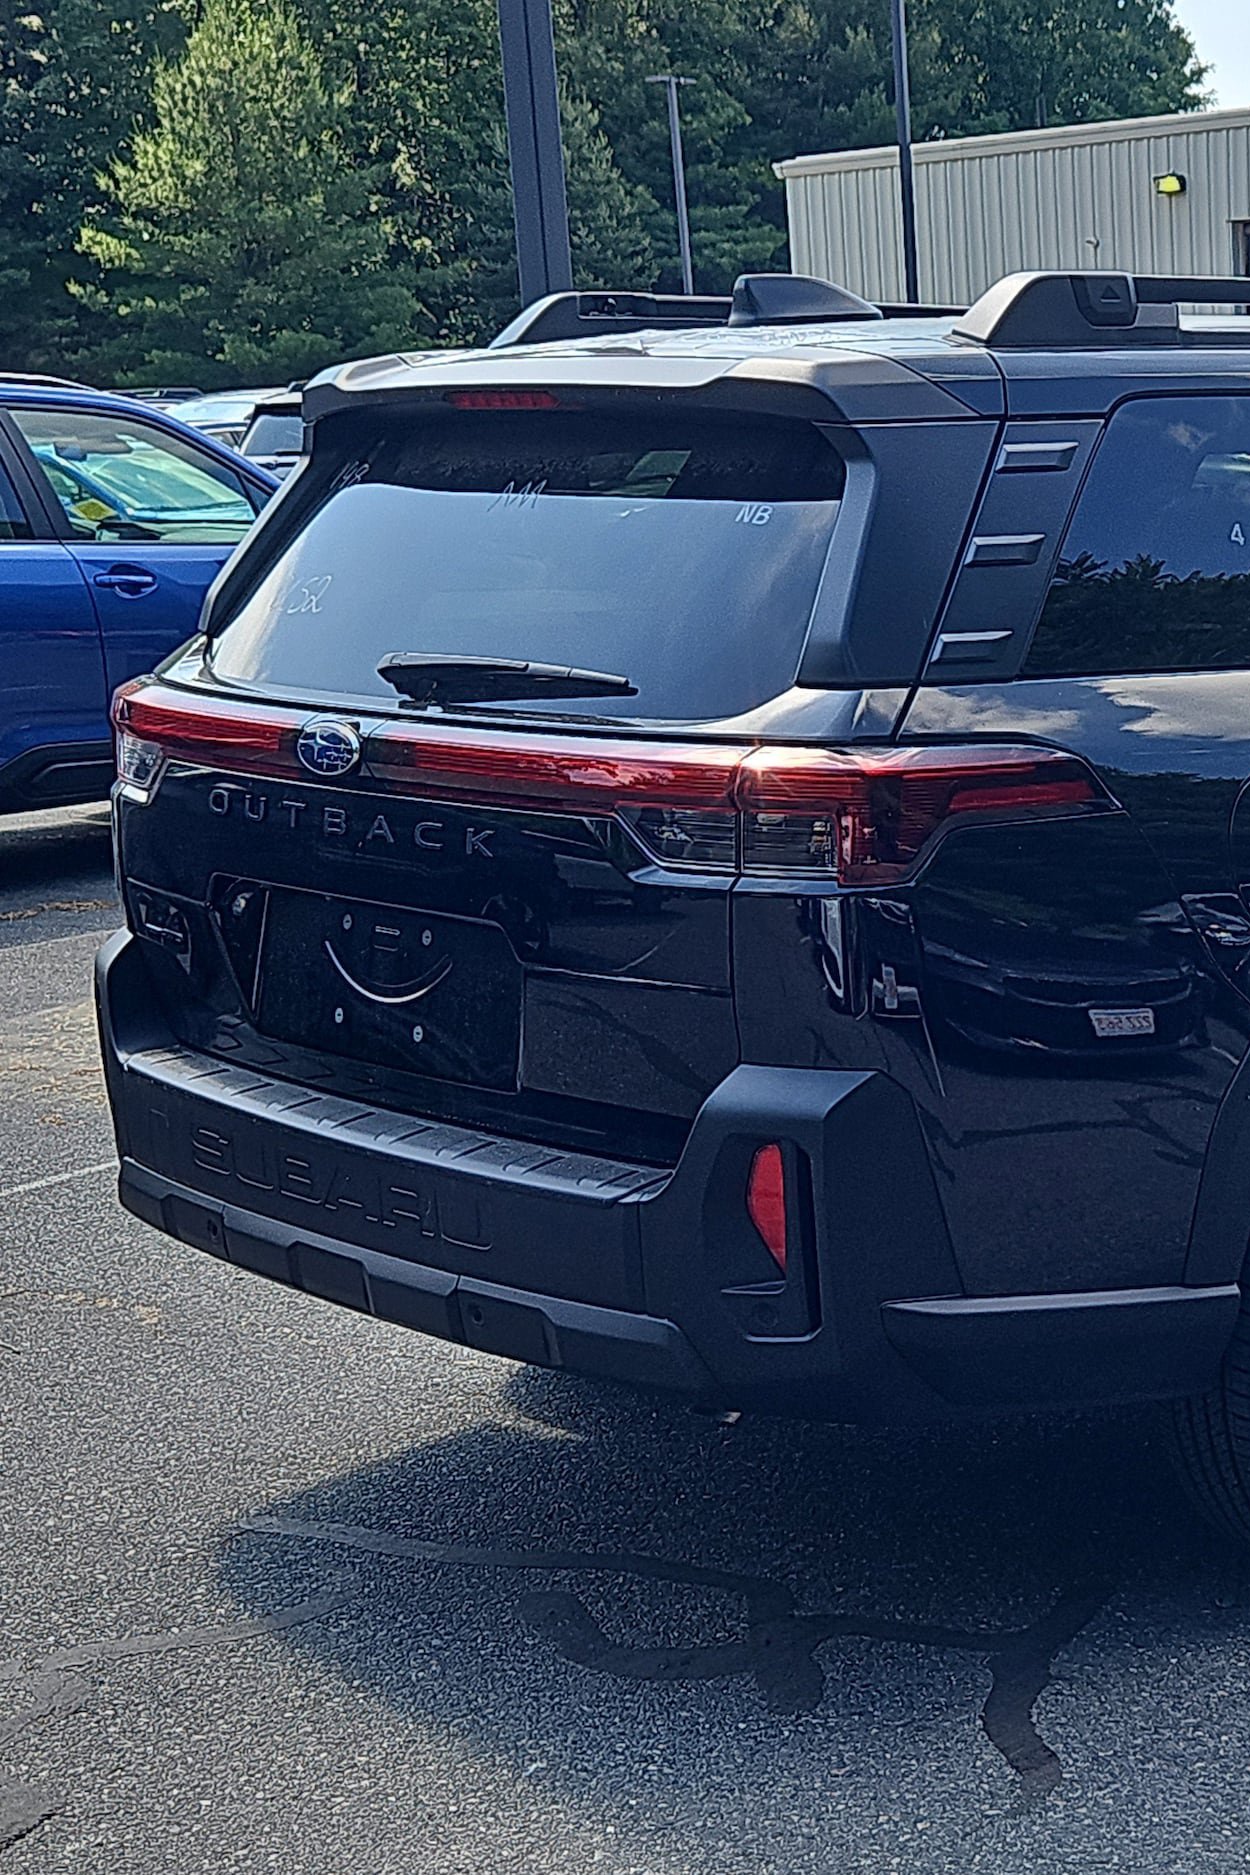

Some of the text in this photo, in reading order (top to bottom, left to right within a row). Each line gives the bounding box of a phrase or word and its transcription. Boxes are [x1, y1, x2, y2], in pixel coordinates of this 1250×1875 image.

[735, 503, 773, 525] NB
[1230, 523, 1245, 546] 4
[208, 786, 496, 858] OUTBACK
[192, 1127, 493, 1251] SUBARU
